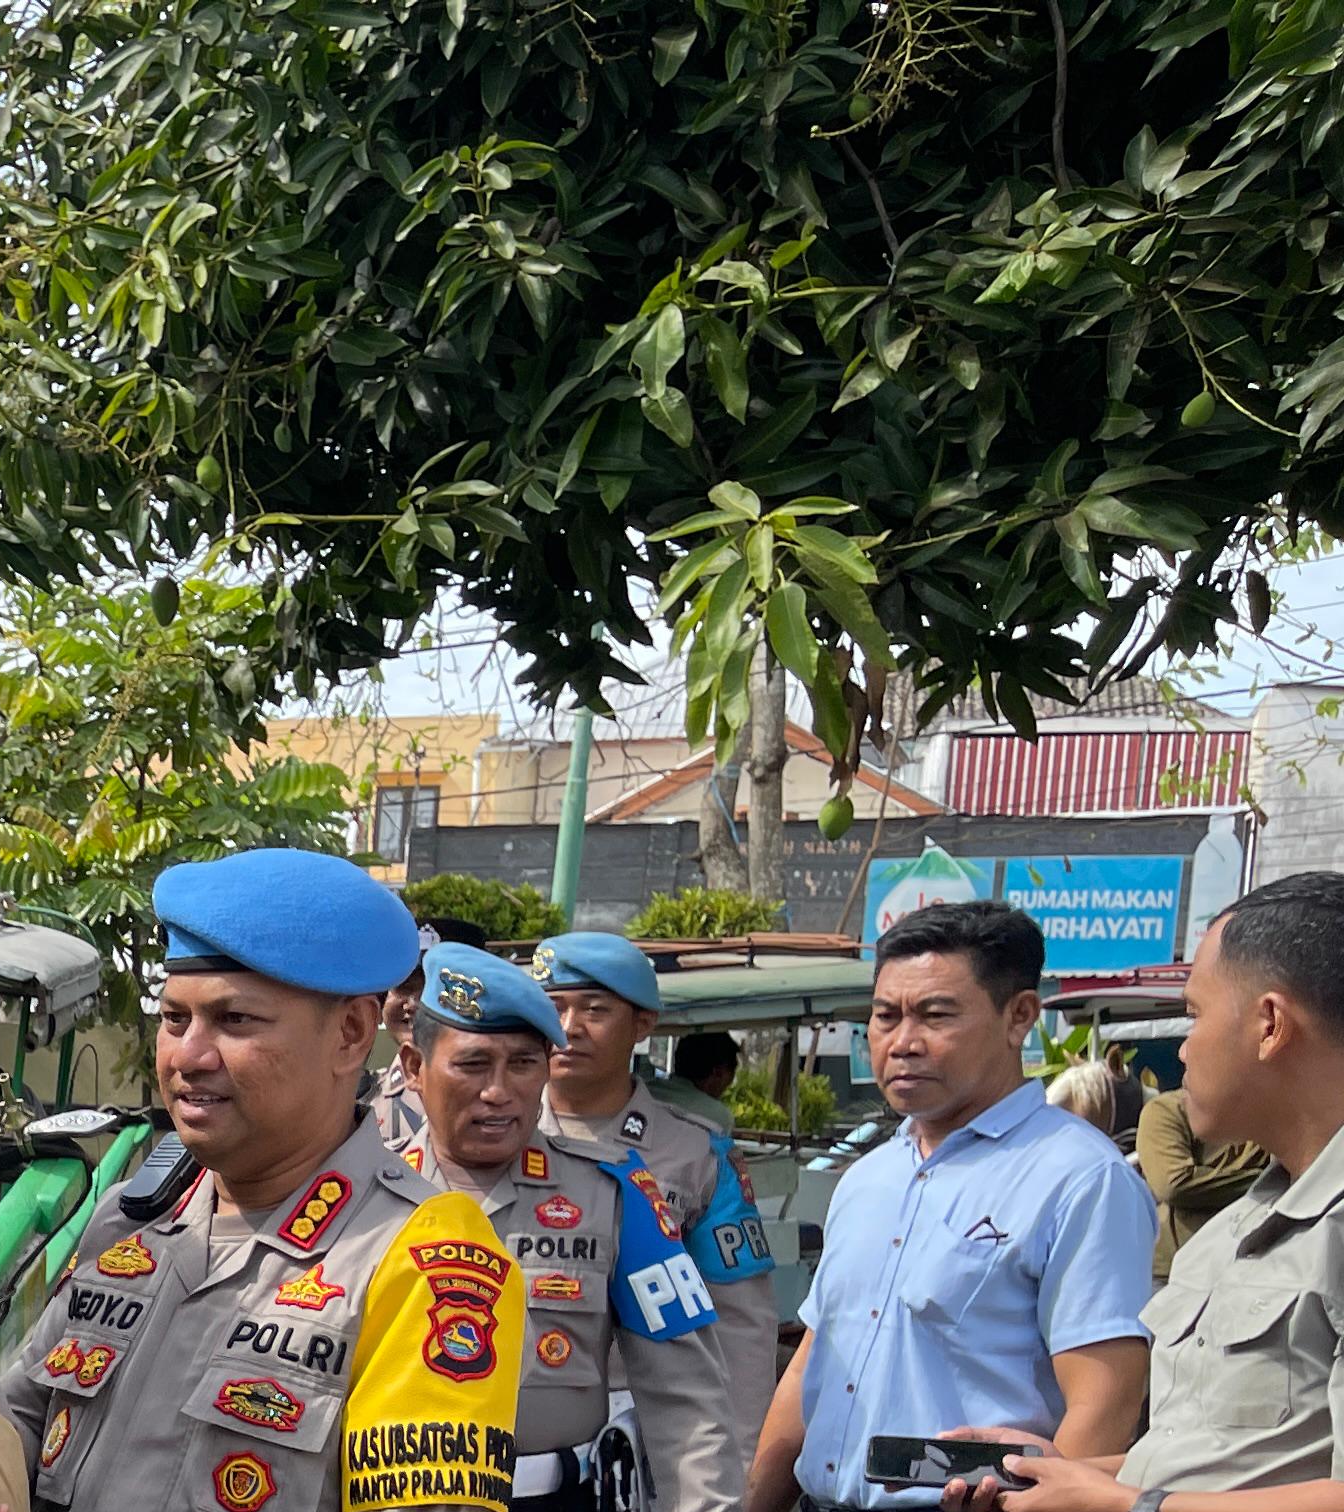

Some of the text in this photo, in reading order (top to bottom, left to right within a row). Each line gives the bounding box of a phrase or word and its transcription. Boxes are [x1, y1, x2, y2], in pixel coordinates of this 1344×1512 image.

[1008, 889, 1174, 909] RUMAH MAKAN
[419, 1244, 502, 1276] POLDA
[517, 1236, 597, 1261] POLRI
[227, 1319, 348, 1375] POLRI
[350, 1471, 408, 1506] MANTAP
[412, 1468, 466, 1497] PRAJA
